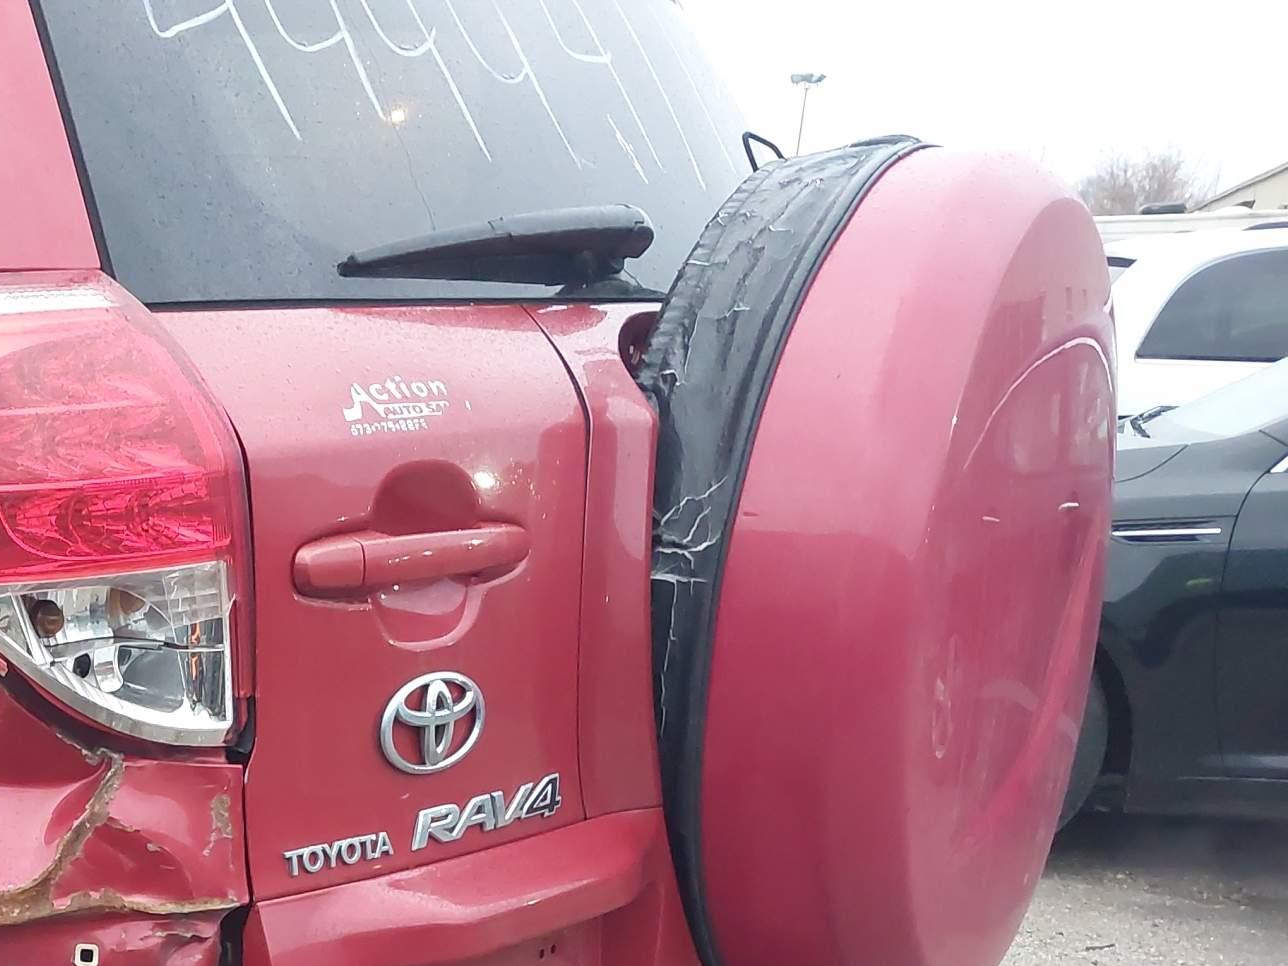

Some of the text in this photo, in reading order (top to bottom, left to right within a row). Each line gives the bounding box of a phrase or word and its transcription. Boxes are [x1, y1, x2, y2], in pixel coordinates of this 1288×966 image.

[343, 375, 449, 422] Action
[283, 772, 562, 876] TOYOTA RAV4
